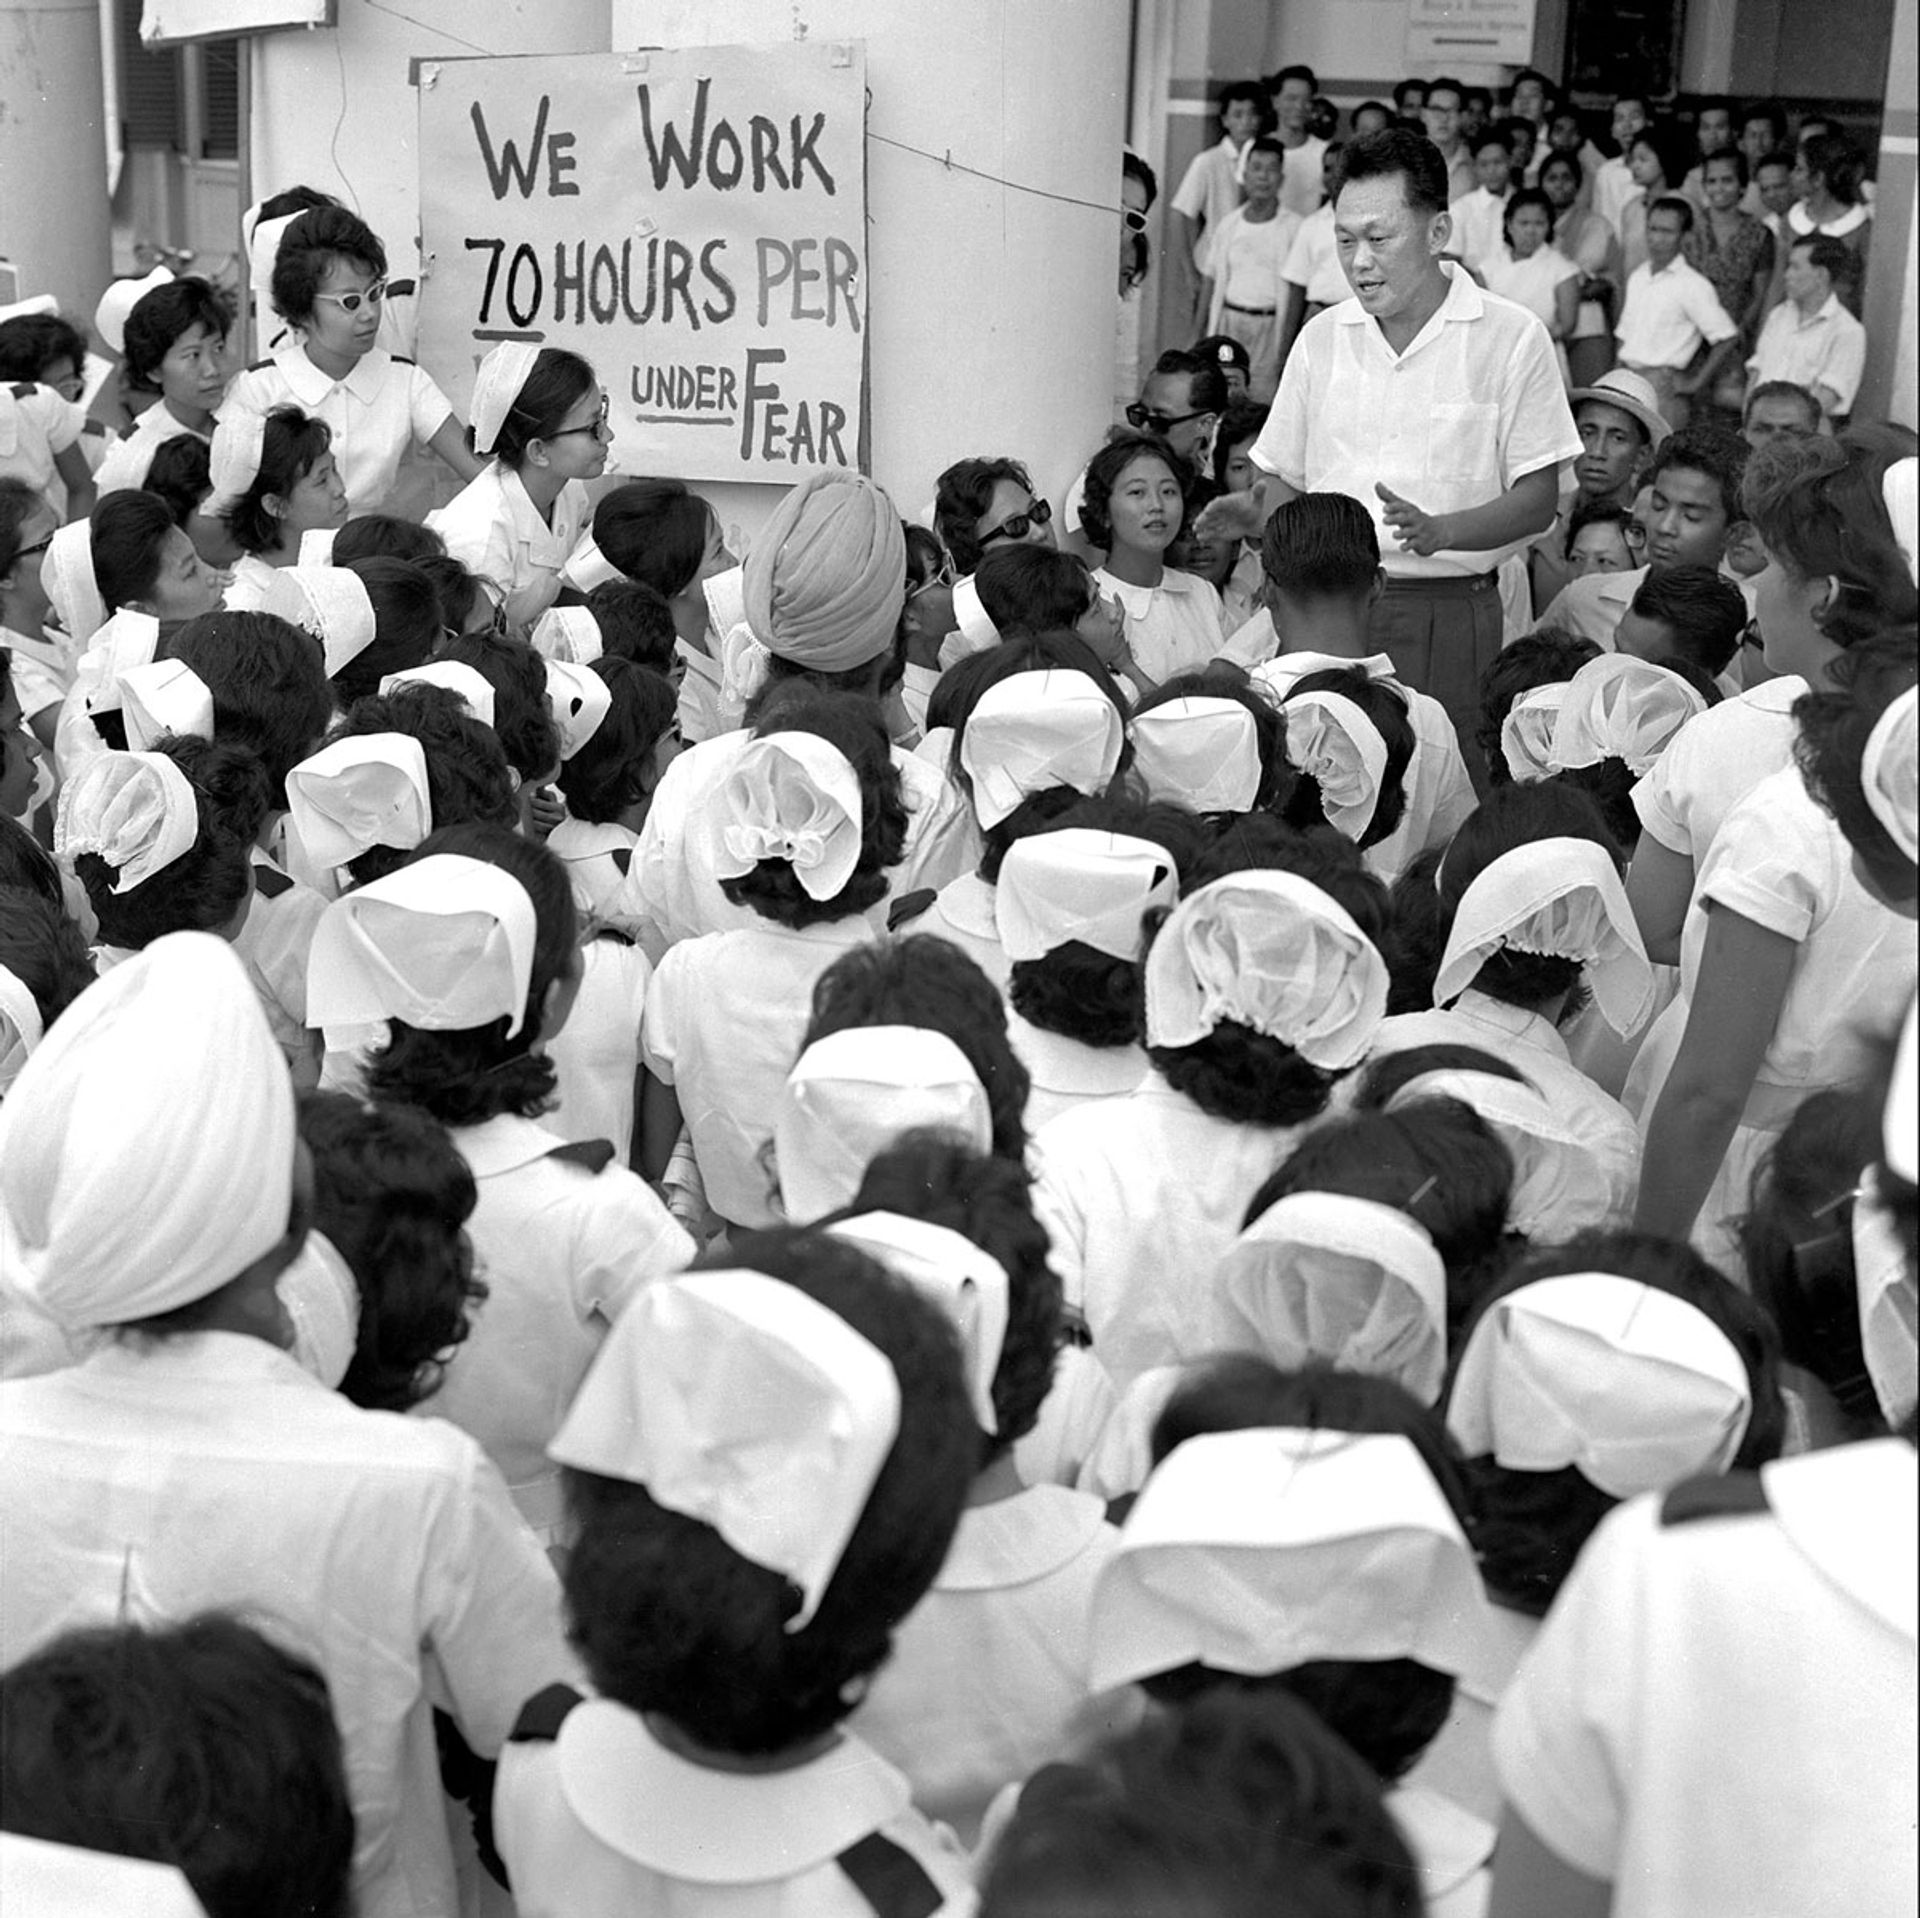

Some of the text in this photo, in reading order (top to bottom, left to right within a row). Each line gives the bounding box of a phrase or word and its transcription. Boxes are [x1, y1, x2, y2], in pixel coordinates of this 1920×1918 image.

[471, 78, 835, 199] WE WORK
[465, 238, 860, 333] 70 HOURS PER
[632, 348, 847, 466] UNDER FEAR
